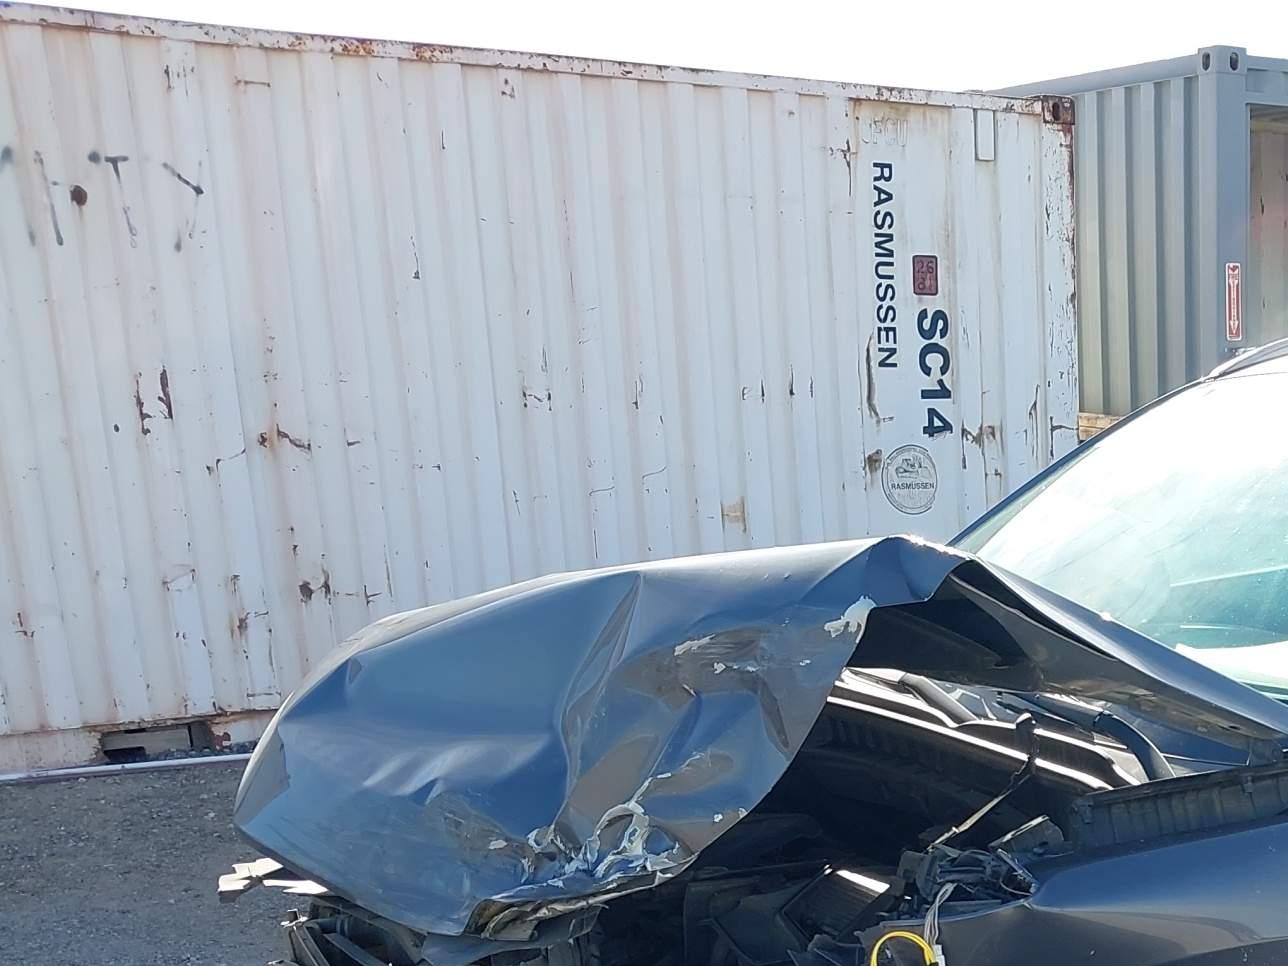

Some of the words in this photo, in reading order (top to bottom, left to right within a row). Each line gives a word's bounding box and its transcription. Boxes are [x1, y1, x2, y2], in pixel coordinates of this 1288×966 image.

[872, 161, 898, 368] RASMUSSEN
[916, 307, 953, 438] SC14
[890, 482, 935, 490] RASMUSSEN
